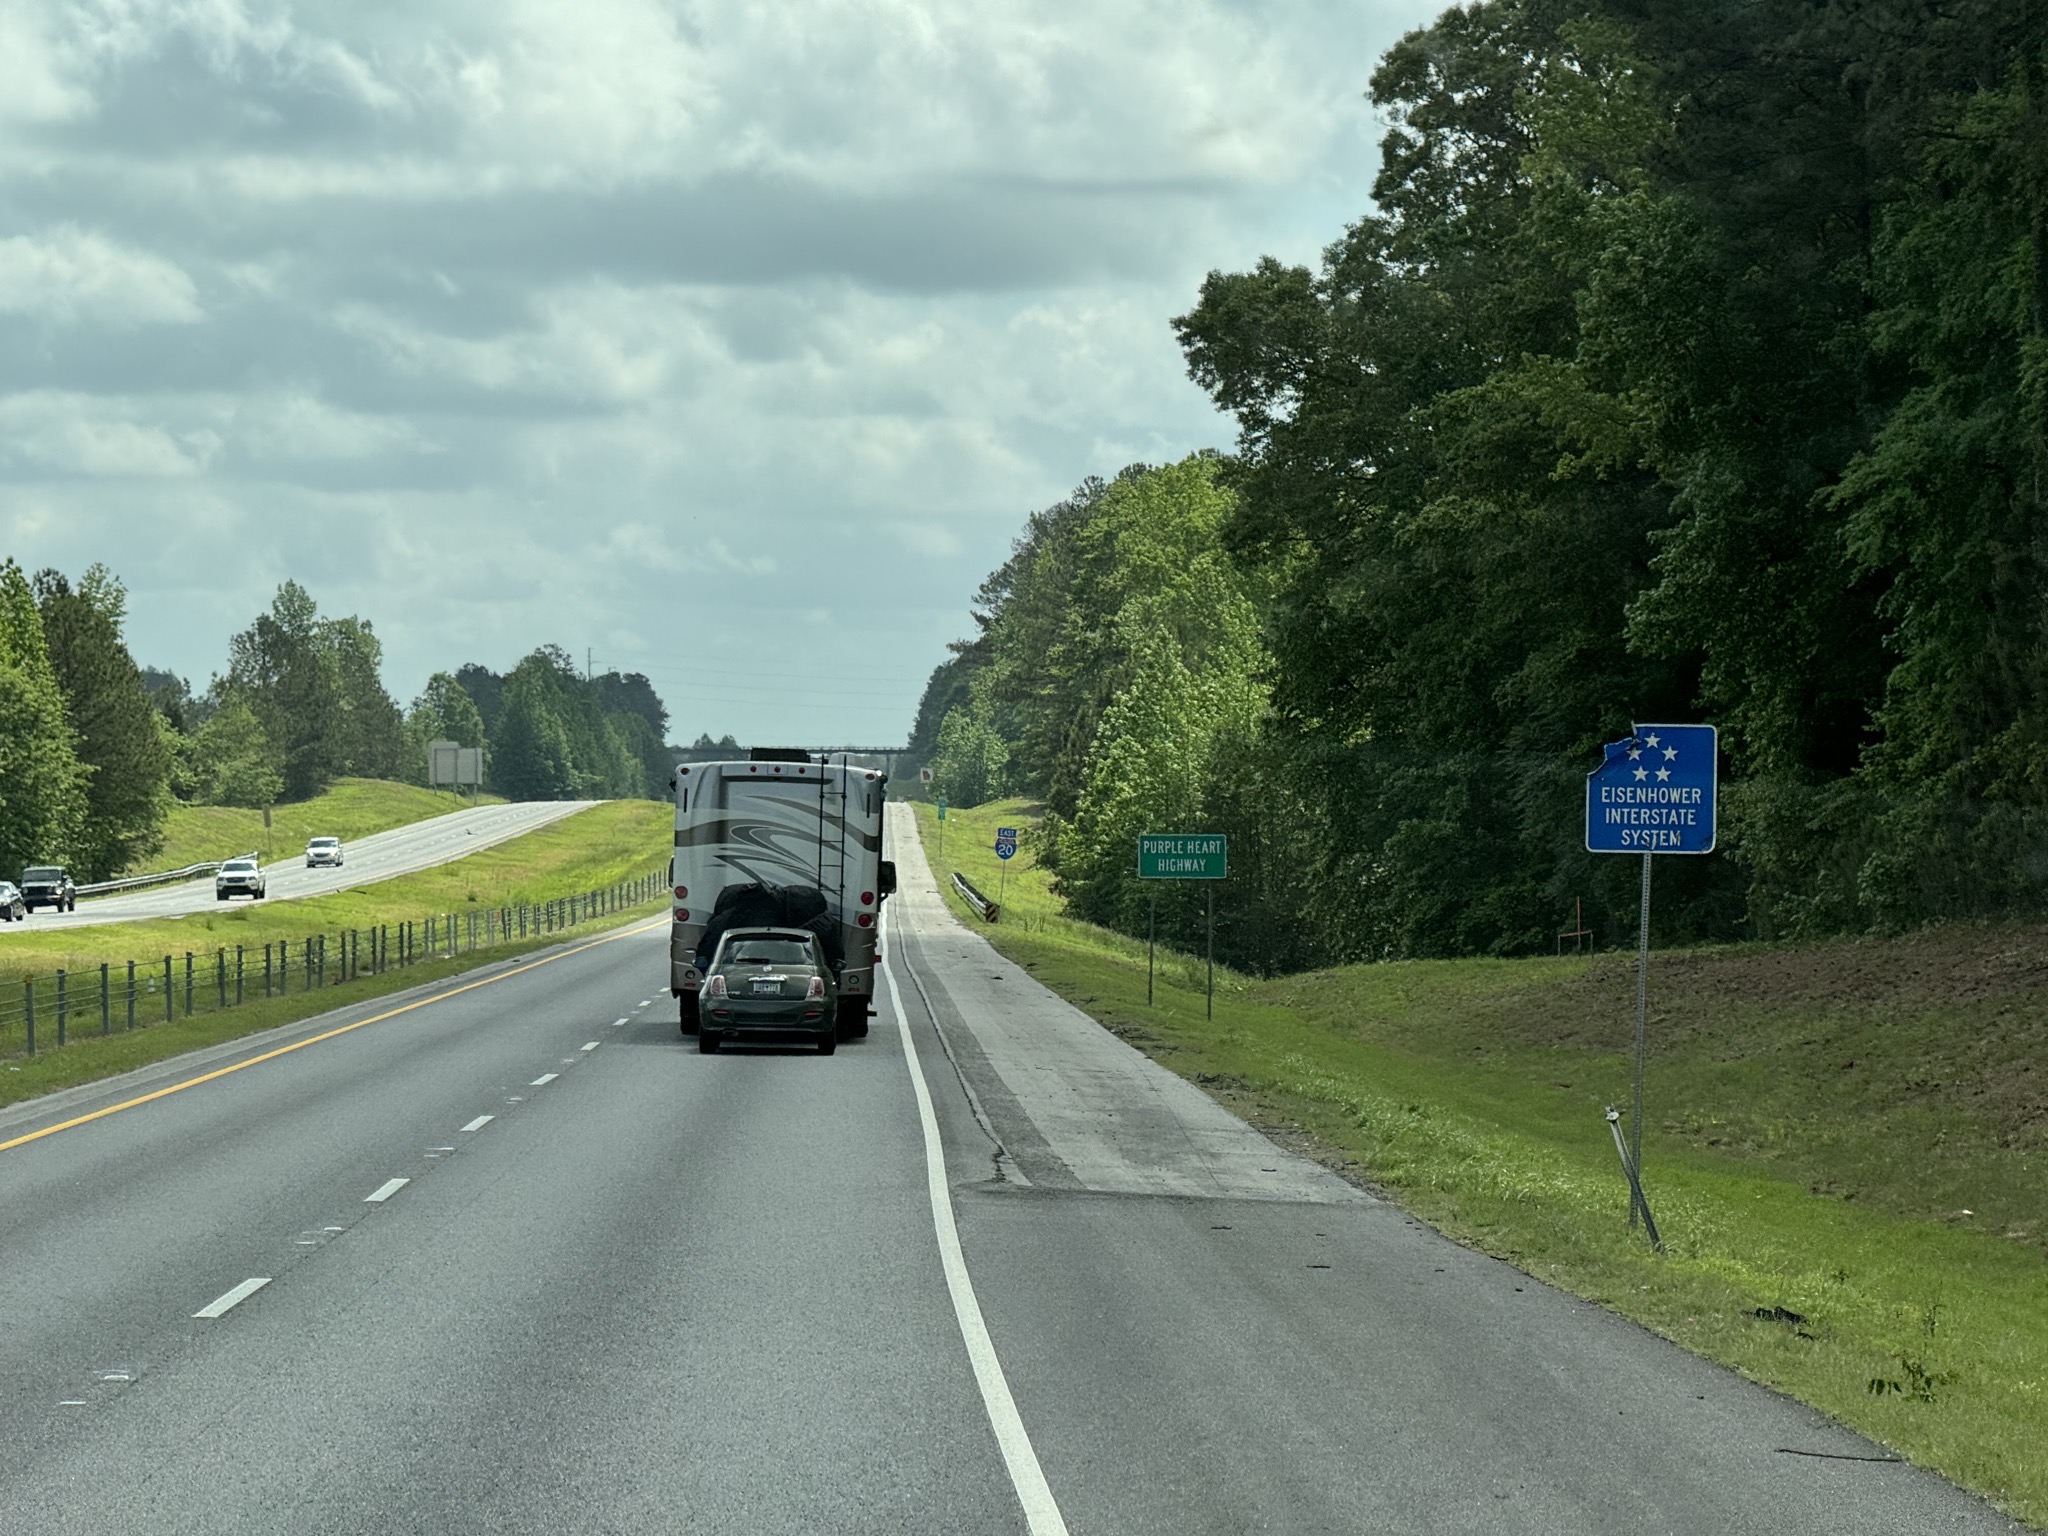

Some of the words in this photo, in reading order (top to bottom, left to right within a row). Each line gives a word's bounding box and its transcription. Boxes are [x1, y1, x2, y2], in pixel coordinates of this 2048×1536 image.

[1601, 786, 1701, 804] EISENHOWER
[1605, 808, 1697, 825] INTERSTATE
[1000, 829, 1015, 837] EAST
[1621, 829, 1681, 847] SYSTEM
[998, 844, 1014, 856] 20
[1143, 840, 1184, 854] PURPLE
[1187, 840, 1221, 854] HEART
[1158, 858, 1206, 872] HIGHWAY
